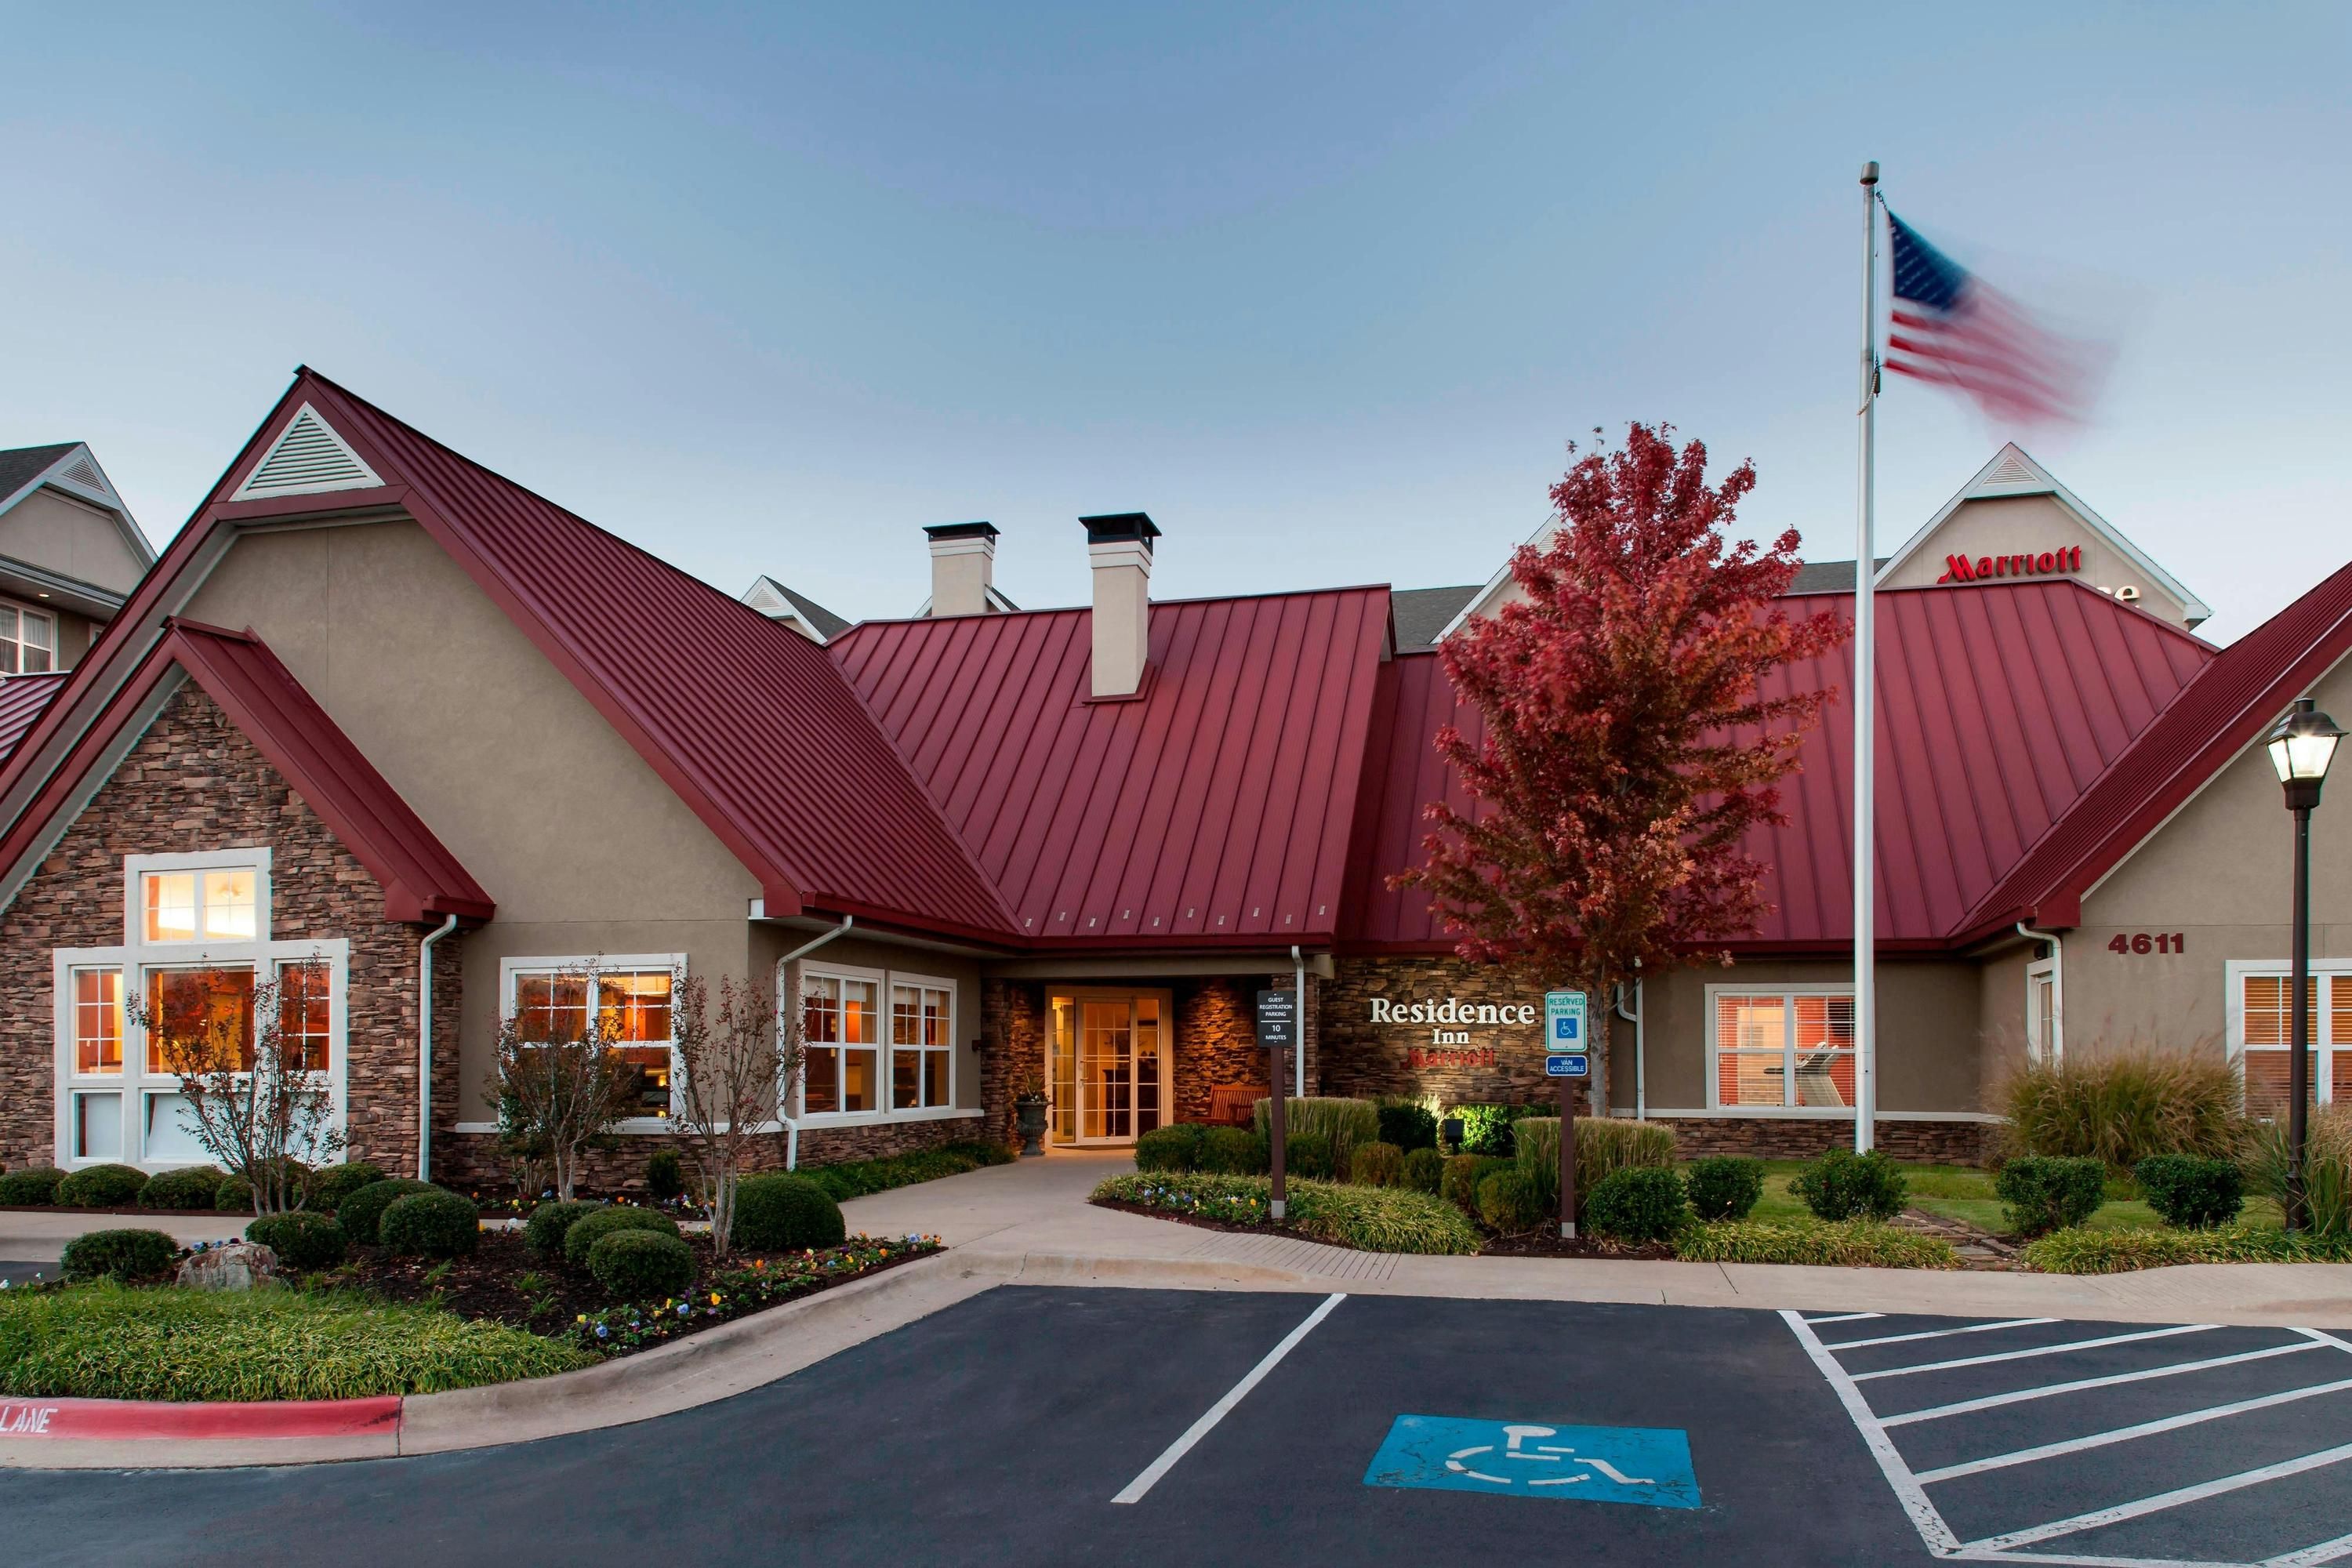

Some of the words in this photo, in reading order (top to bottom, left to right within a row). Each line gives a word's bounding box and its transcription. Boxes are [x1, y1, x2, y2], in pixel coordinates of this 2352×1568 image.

[1936, 546, 2082, 584] Marriott
[2107, 932, 2184, 955] 4611
[1370, 998, 1536, 1025] Residence
[1272, 1024, 1281, 1033] 10
[1432, 1028, 1470, 1044] Inn
[1401, 1047, 1496, 1069] Marriott
[0, 1406, 59, 1433] LANE
